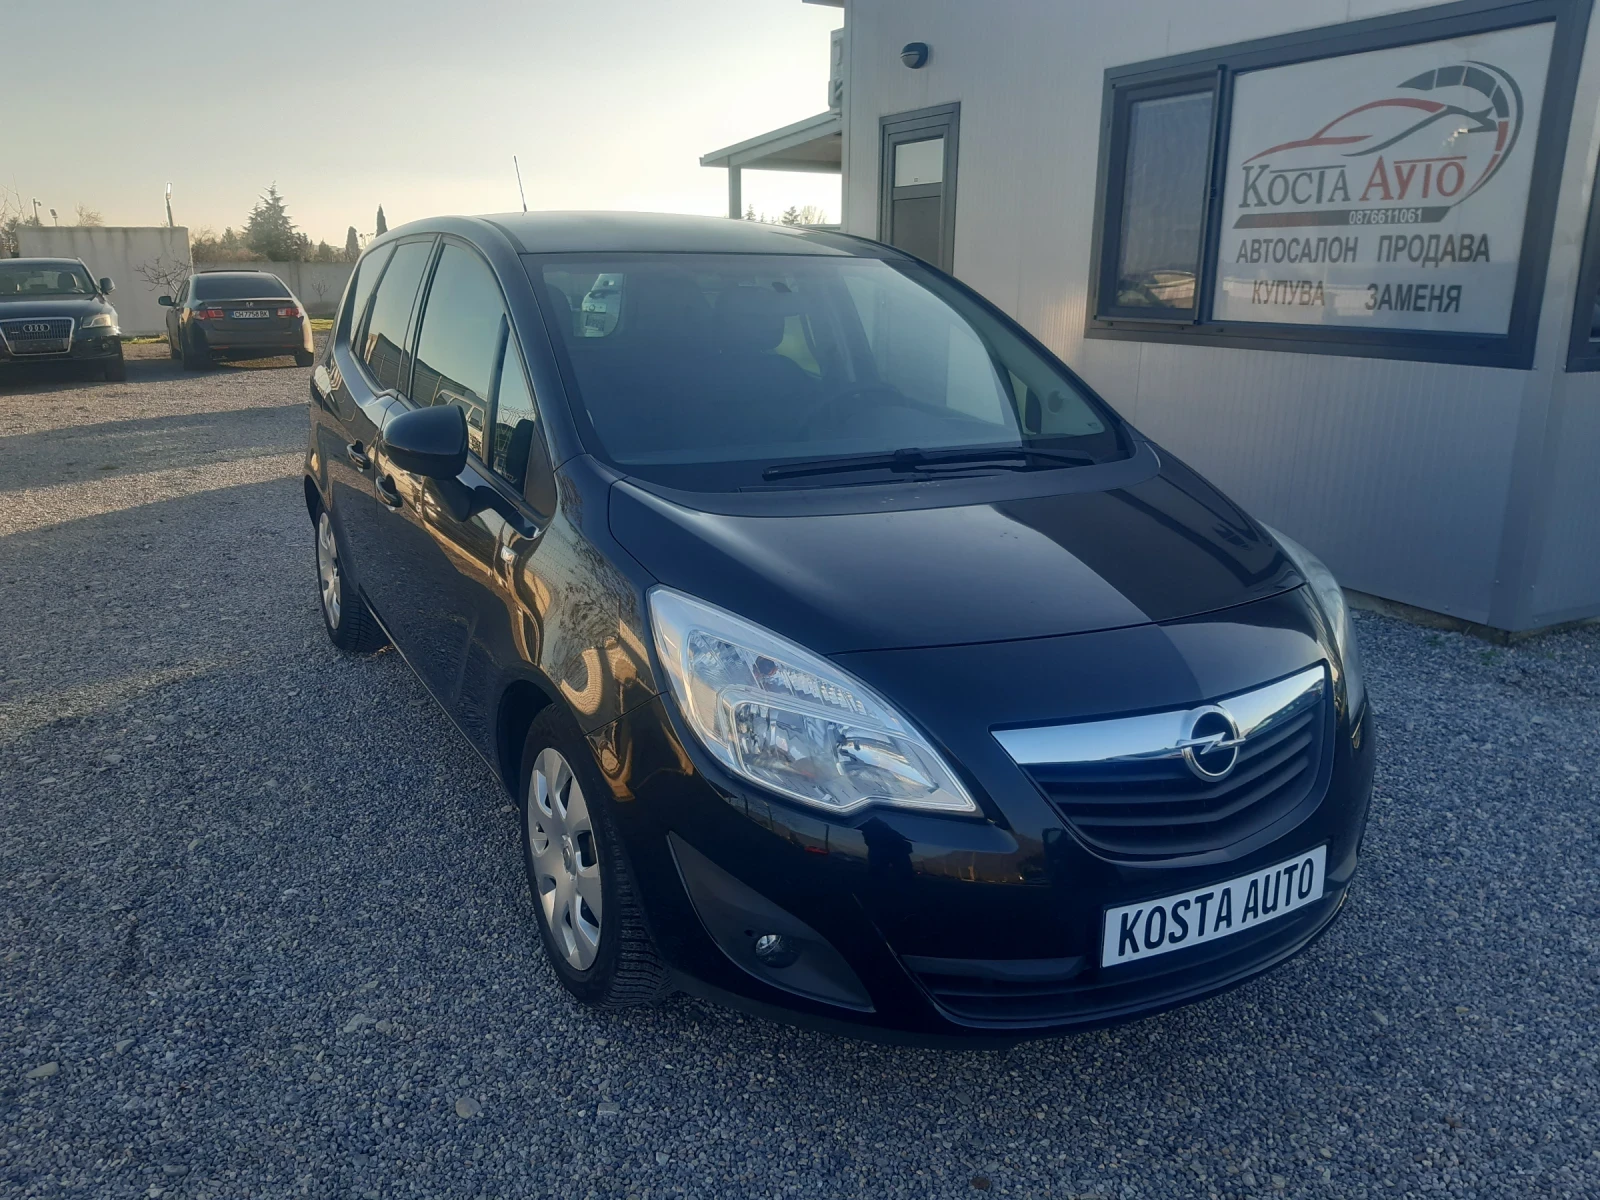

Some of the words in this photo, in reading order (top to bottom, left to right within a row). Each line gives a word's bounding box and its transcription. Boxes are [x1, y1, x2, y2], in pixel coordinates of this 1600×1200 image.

[1349, 208, 1423, 225] 0876611061
[1236, 236, 1358, 263] АВТОСАЛОН
[1376, 233, 1490, 268] ПРОДАВА
[1251, 279, 1325, 306] КУПУВА
[1364, 283, 1462, 313] ЗАМЕНЯ
[1118, 887, 1233, 957] KOSTA
[1241, 858, 1315, 924] AUTO
